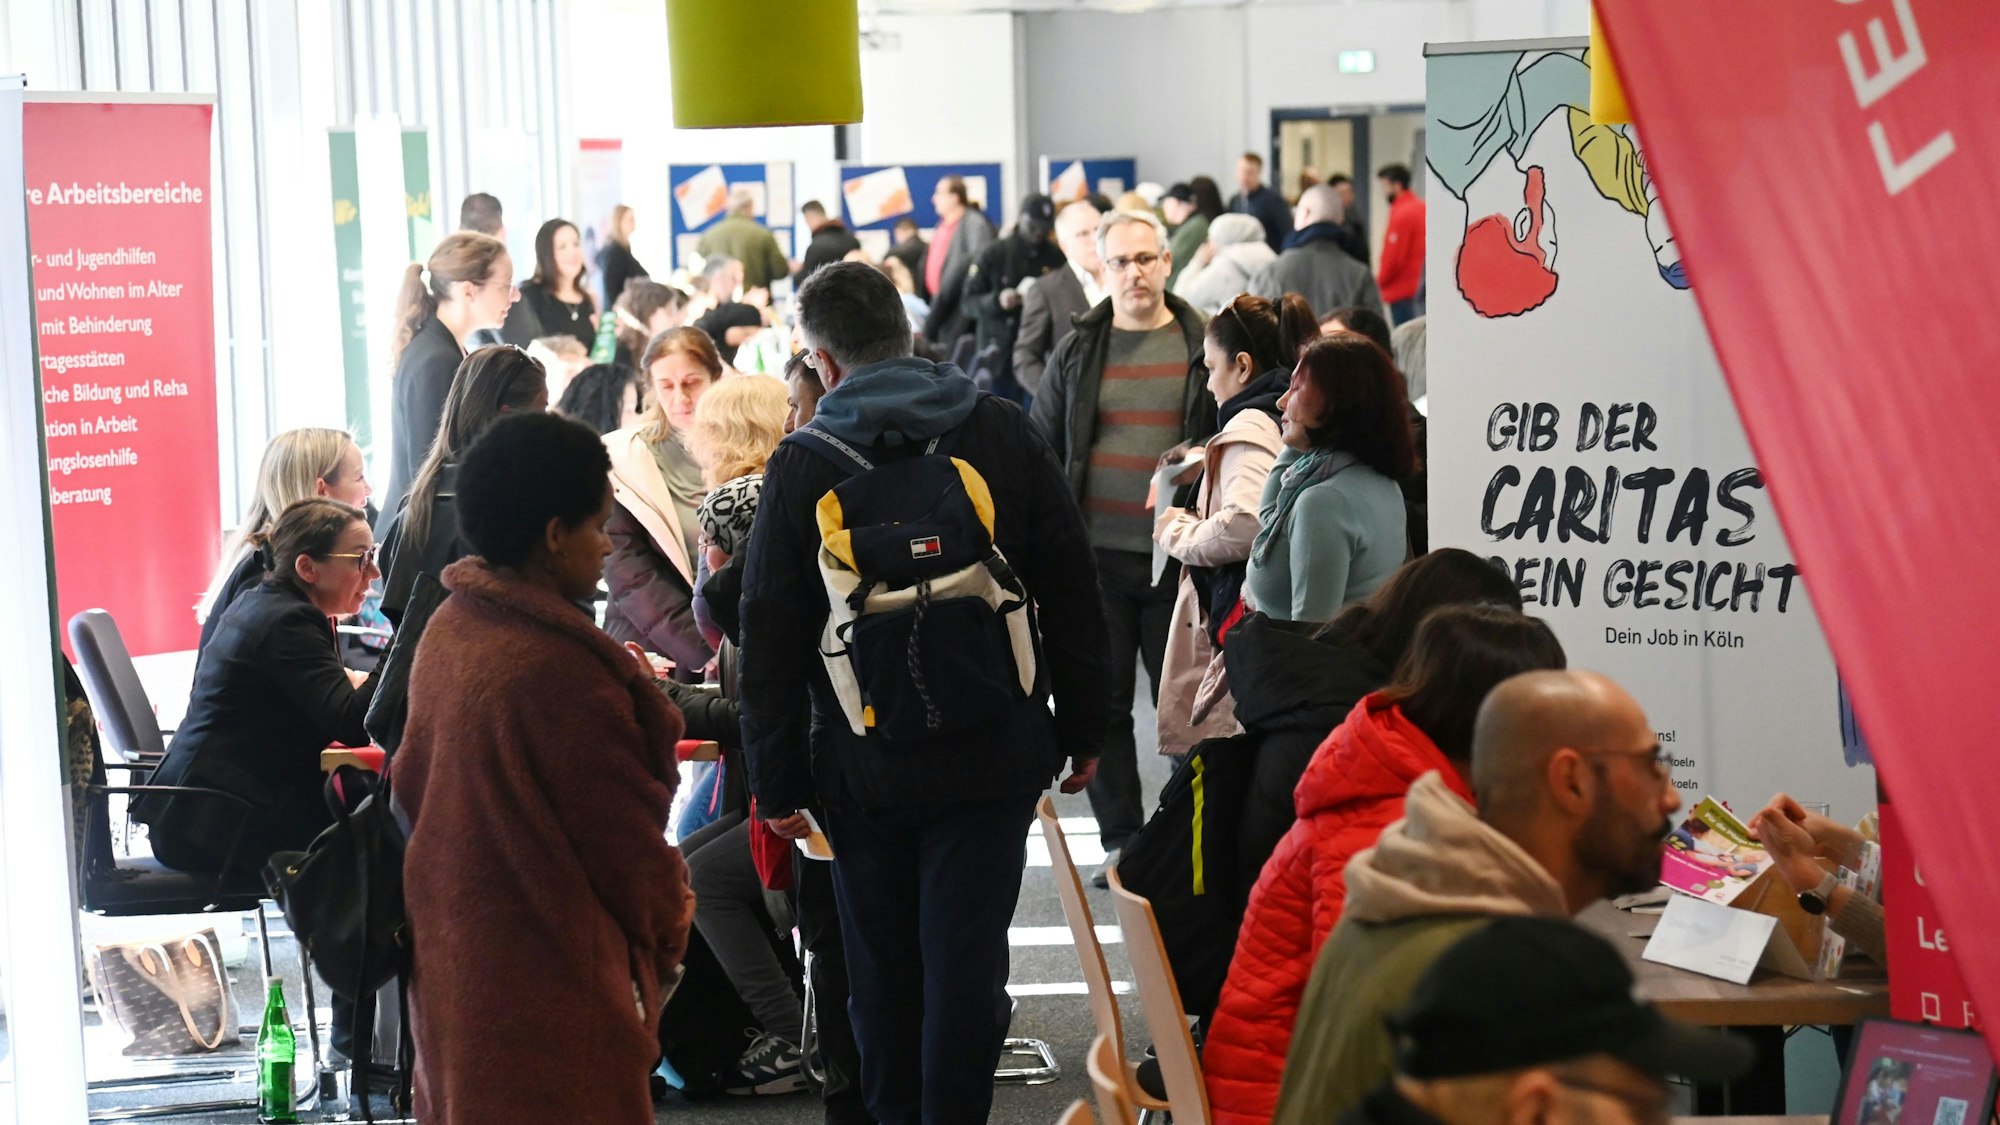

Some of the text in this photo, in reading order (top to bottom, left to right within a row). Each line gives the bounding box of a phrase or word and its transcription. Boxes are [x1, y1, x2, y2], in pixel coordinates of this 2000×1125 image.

[1834, 0, 1957, 196] LE
[47, 180, 203, 204] Arbeitsbereiche
[47, 248, 73, 267] und
[76, 247, 156, 271] Jugendhilfen
[38, 279, 183, 301] und Wohnen im Alter
[41, 315, 153, 336] mit Behinderung
[42, 379, 189, 404] che Bildung und Reha
[80, 418, 93, 435] in
[95, 415, 138, 434] Arbeit
[1487, 401, 1658, 452] GIB DER
[50, 486, 112, 505] beratung
[1480, 465, 1765, 547] CARITAS
[1603, 558, 1802, 613] GESICHT
[1605, 627, 1744, 648] Dein Job in Köln
[1655, 730, 1676, 742] ns!
